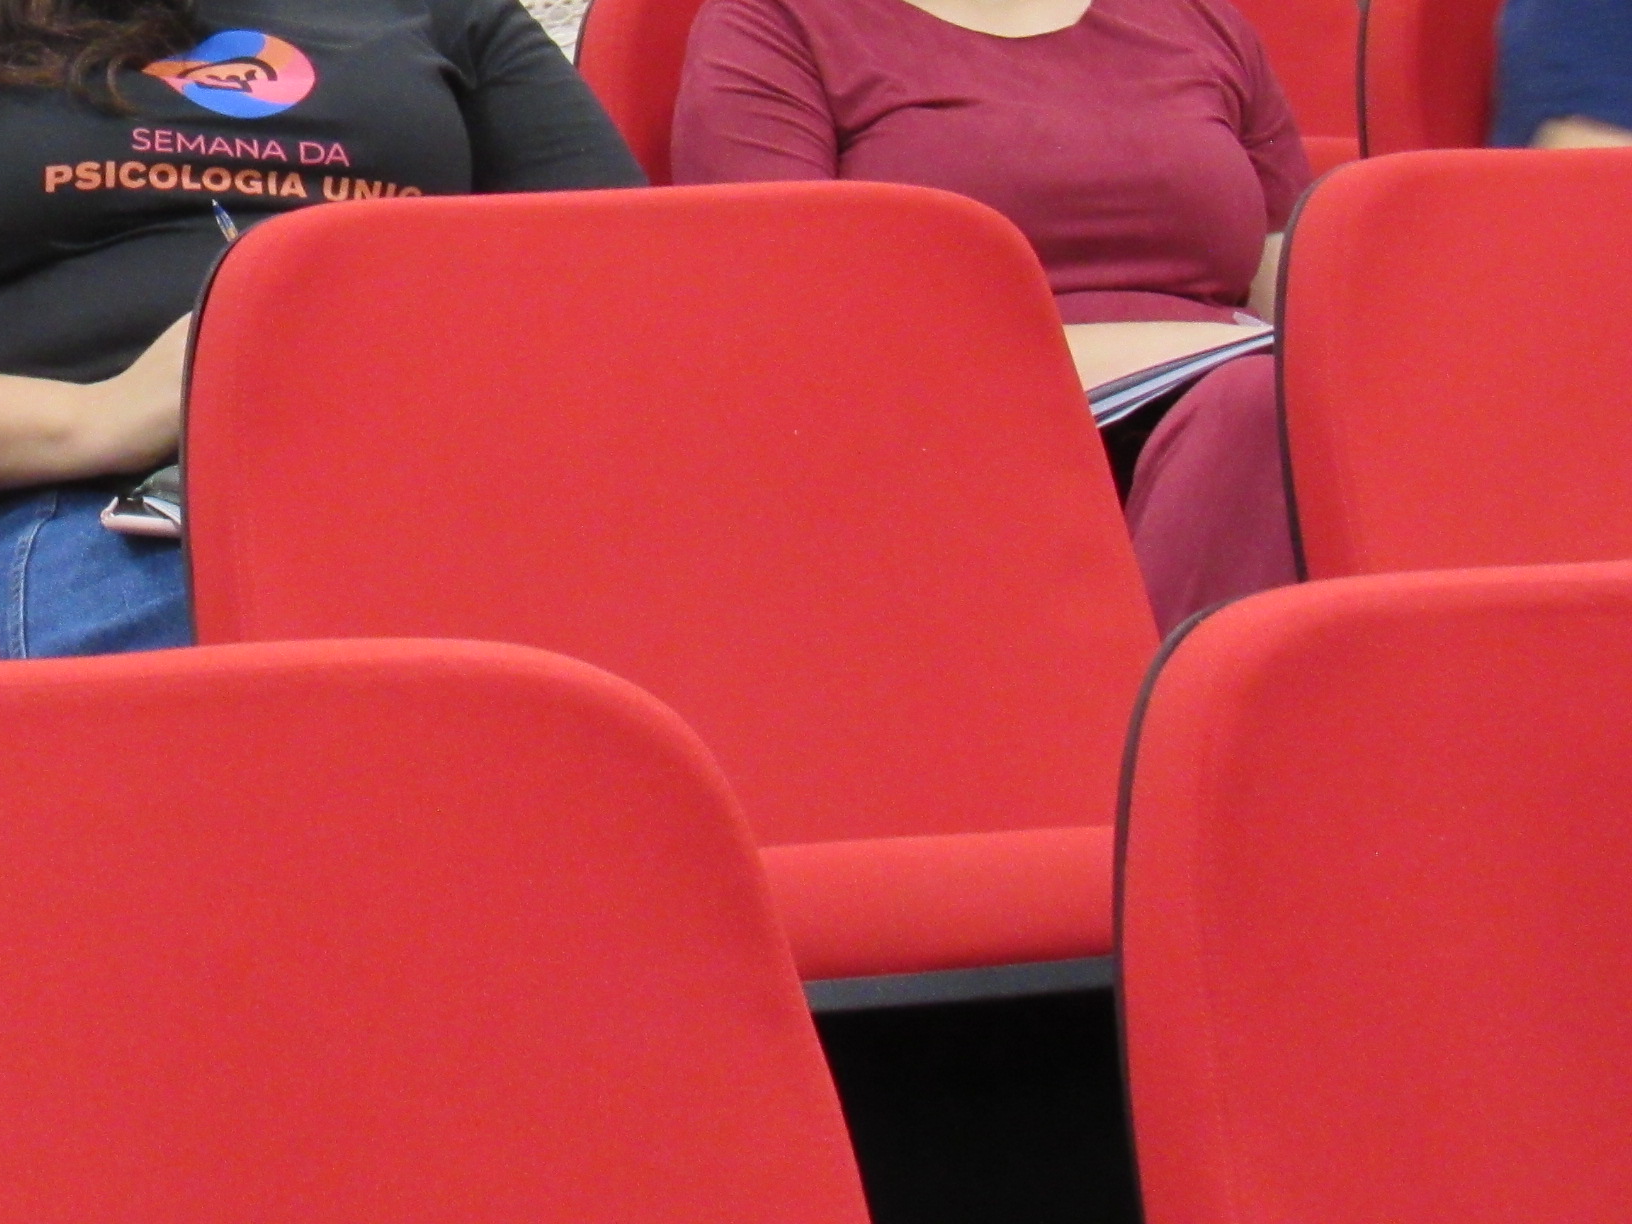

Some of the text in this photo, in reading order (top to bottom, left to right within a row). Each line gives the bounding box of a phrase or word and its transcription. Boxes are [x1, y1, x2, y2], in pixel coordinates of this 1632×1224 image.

[131, 128, 350, 167] SEMANA DA
[44, 160, 307, 198] PSICOLOGIA
